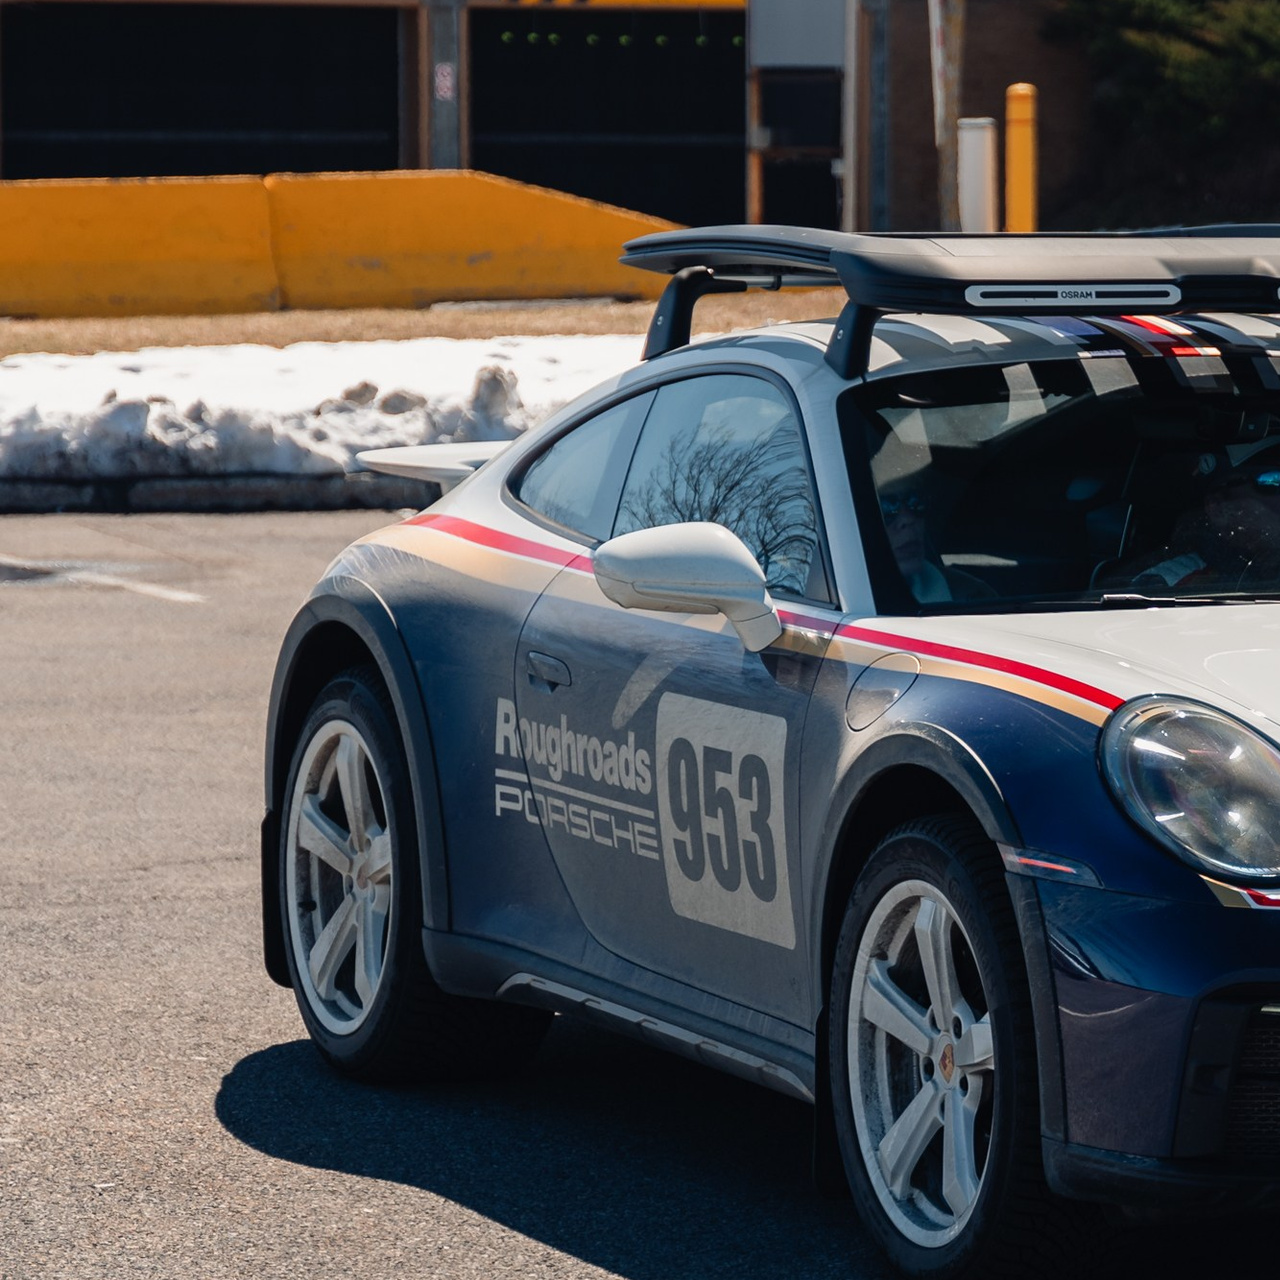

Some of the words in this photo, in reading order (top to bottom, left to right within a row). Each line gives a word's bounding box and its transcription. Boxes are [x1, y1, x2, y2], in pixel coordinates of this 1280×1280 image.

[1060, 290, 1093, 299] OSRAM
[496, 697, 653, 795] Roughroads
[495, 783, 660, 861] PORSCHE
[667, 737, 778, 903] 953
